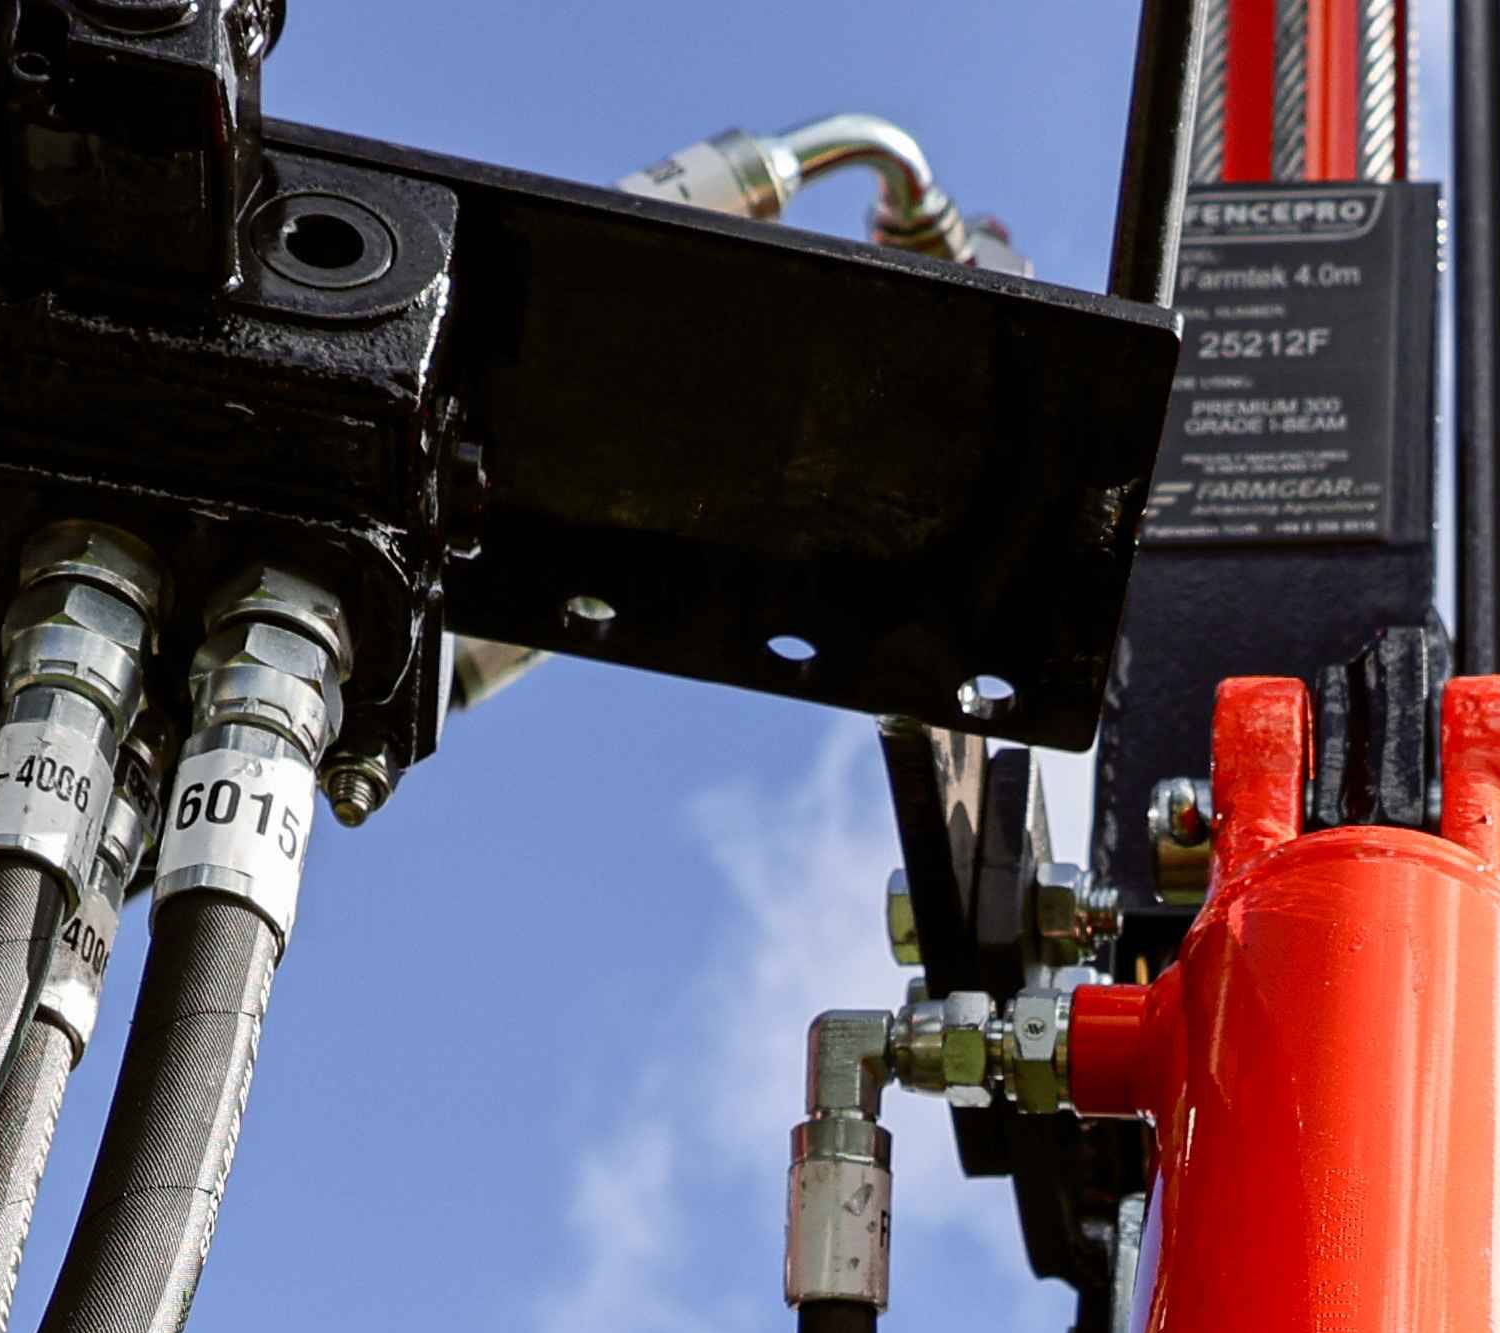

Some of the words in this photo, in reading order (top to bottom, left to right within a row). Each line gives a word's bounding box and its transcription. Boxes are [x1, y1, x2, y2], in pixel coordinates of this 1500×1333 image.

[1181, 266, 1286, 291] Farmtek
[1294, 263, 1362, 286] 4.0m
[1198, 329, 1332, 358] 25212F
[175, 779, 300, 860] 6015
